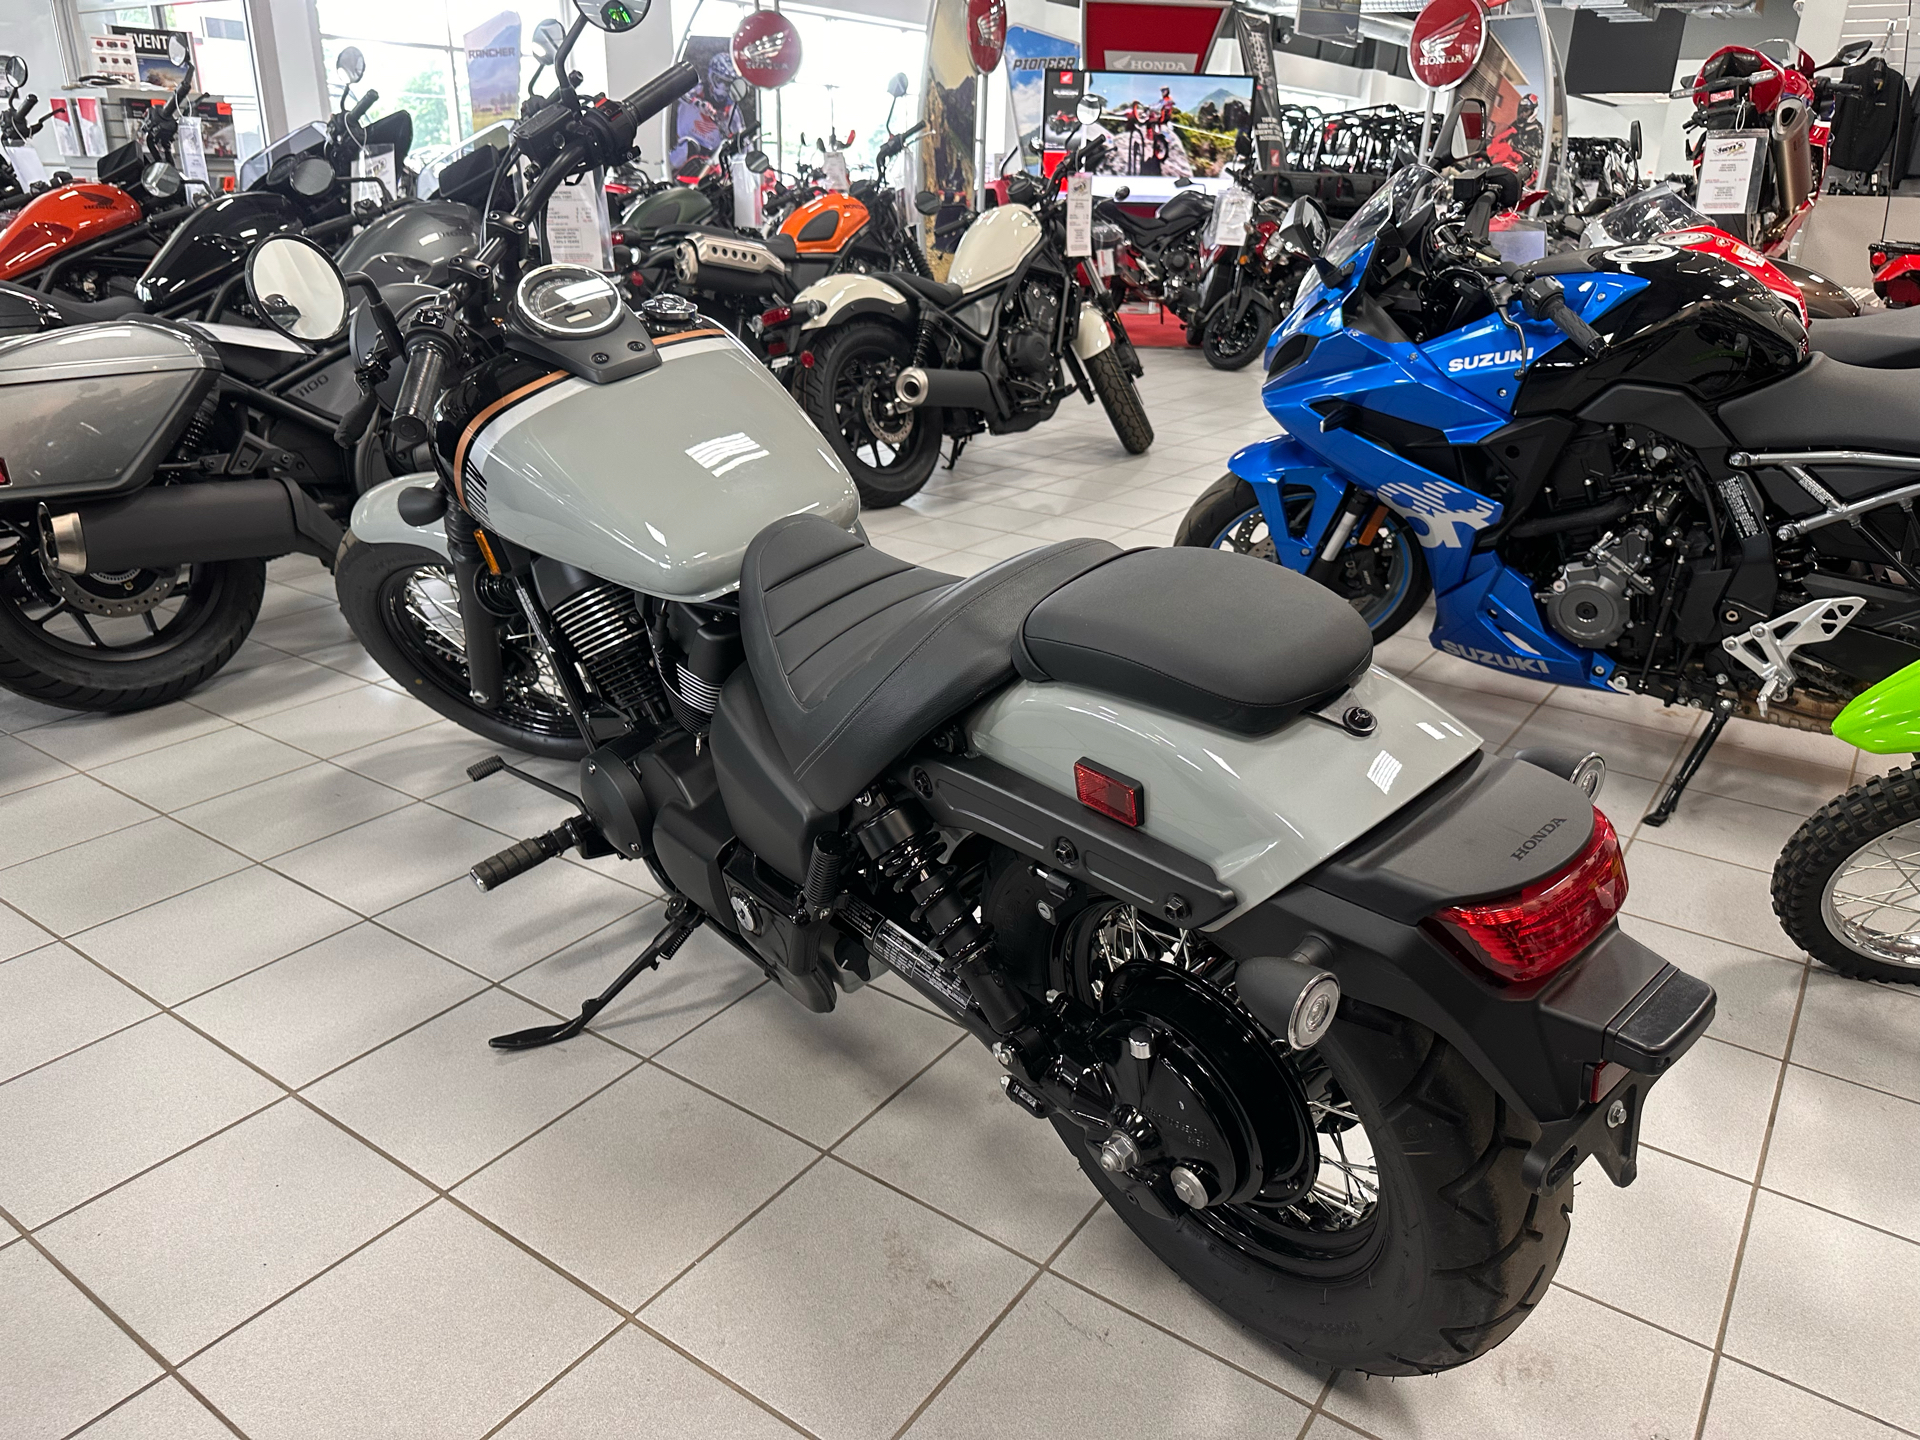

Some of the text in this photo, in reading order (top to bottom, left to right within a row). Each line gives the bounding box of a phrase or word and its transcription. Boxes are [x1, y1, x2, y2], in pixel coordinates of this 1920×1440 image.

[468, 47, 515, 59] RANCHER
[1418, 54, 1465, 66] HONDA
[1012, 57, 1076, 71] PIONEER
[1131, 59, 1188, 72] HONDA
[1447, 346, 1535, 373] SUZUKI
[295, 373, 330, 398] 1100
[1440, 639, 1551, 675] SUZUKI
[1509, 817, 1568, 862] HONDA
